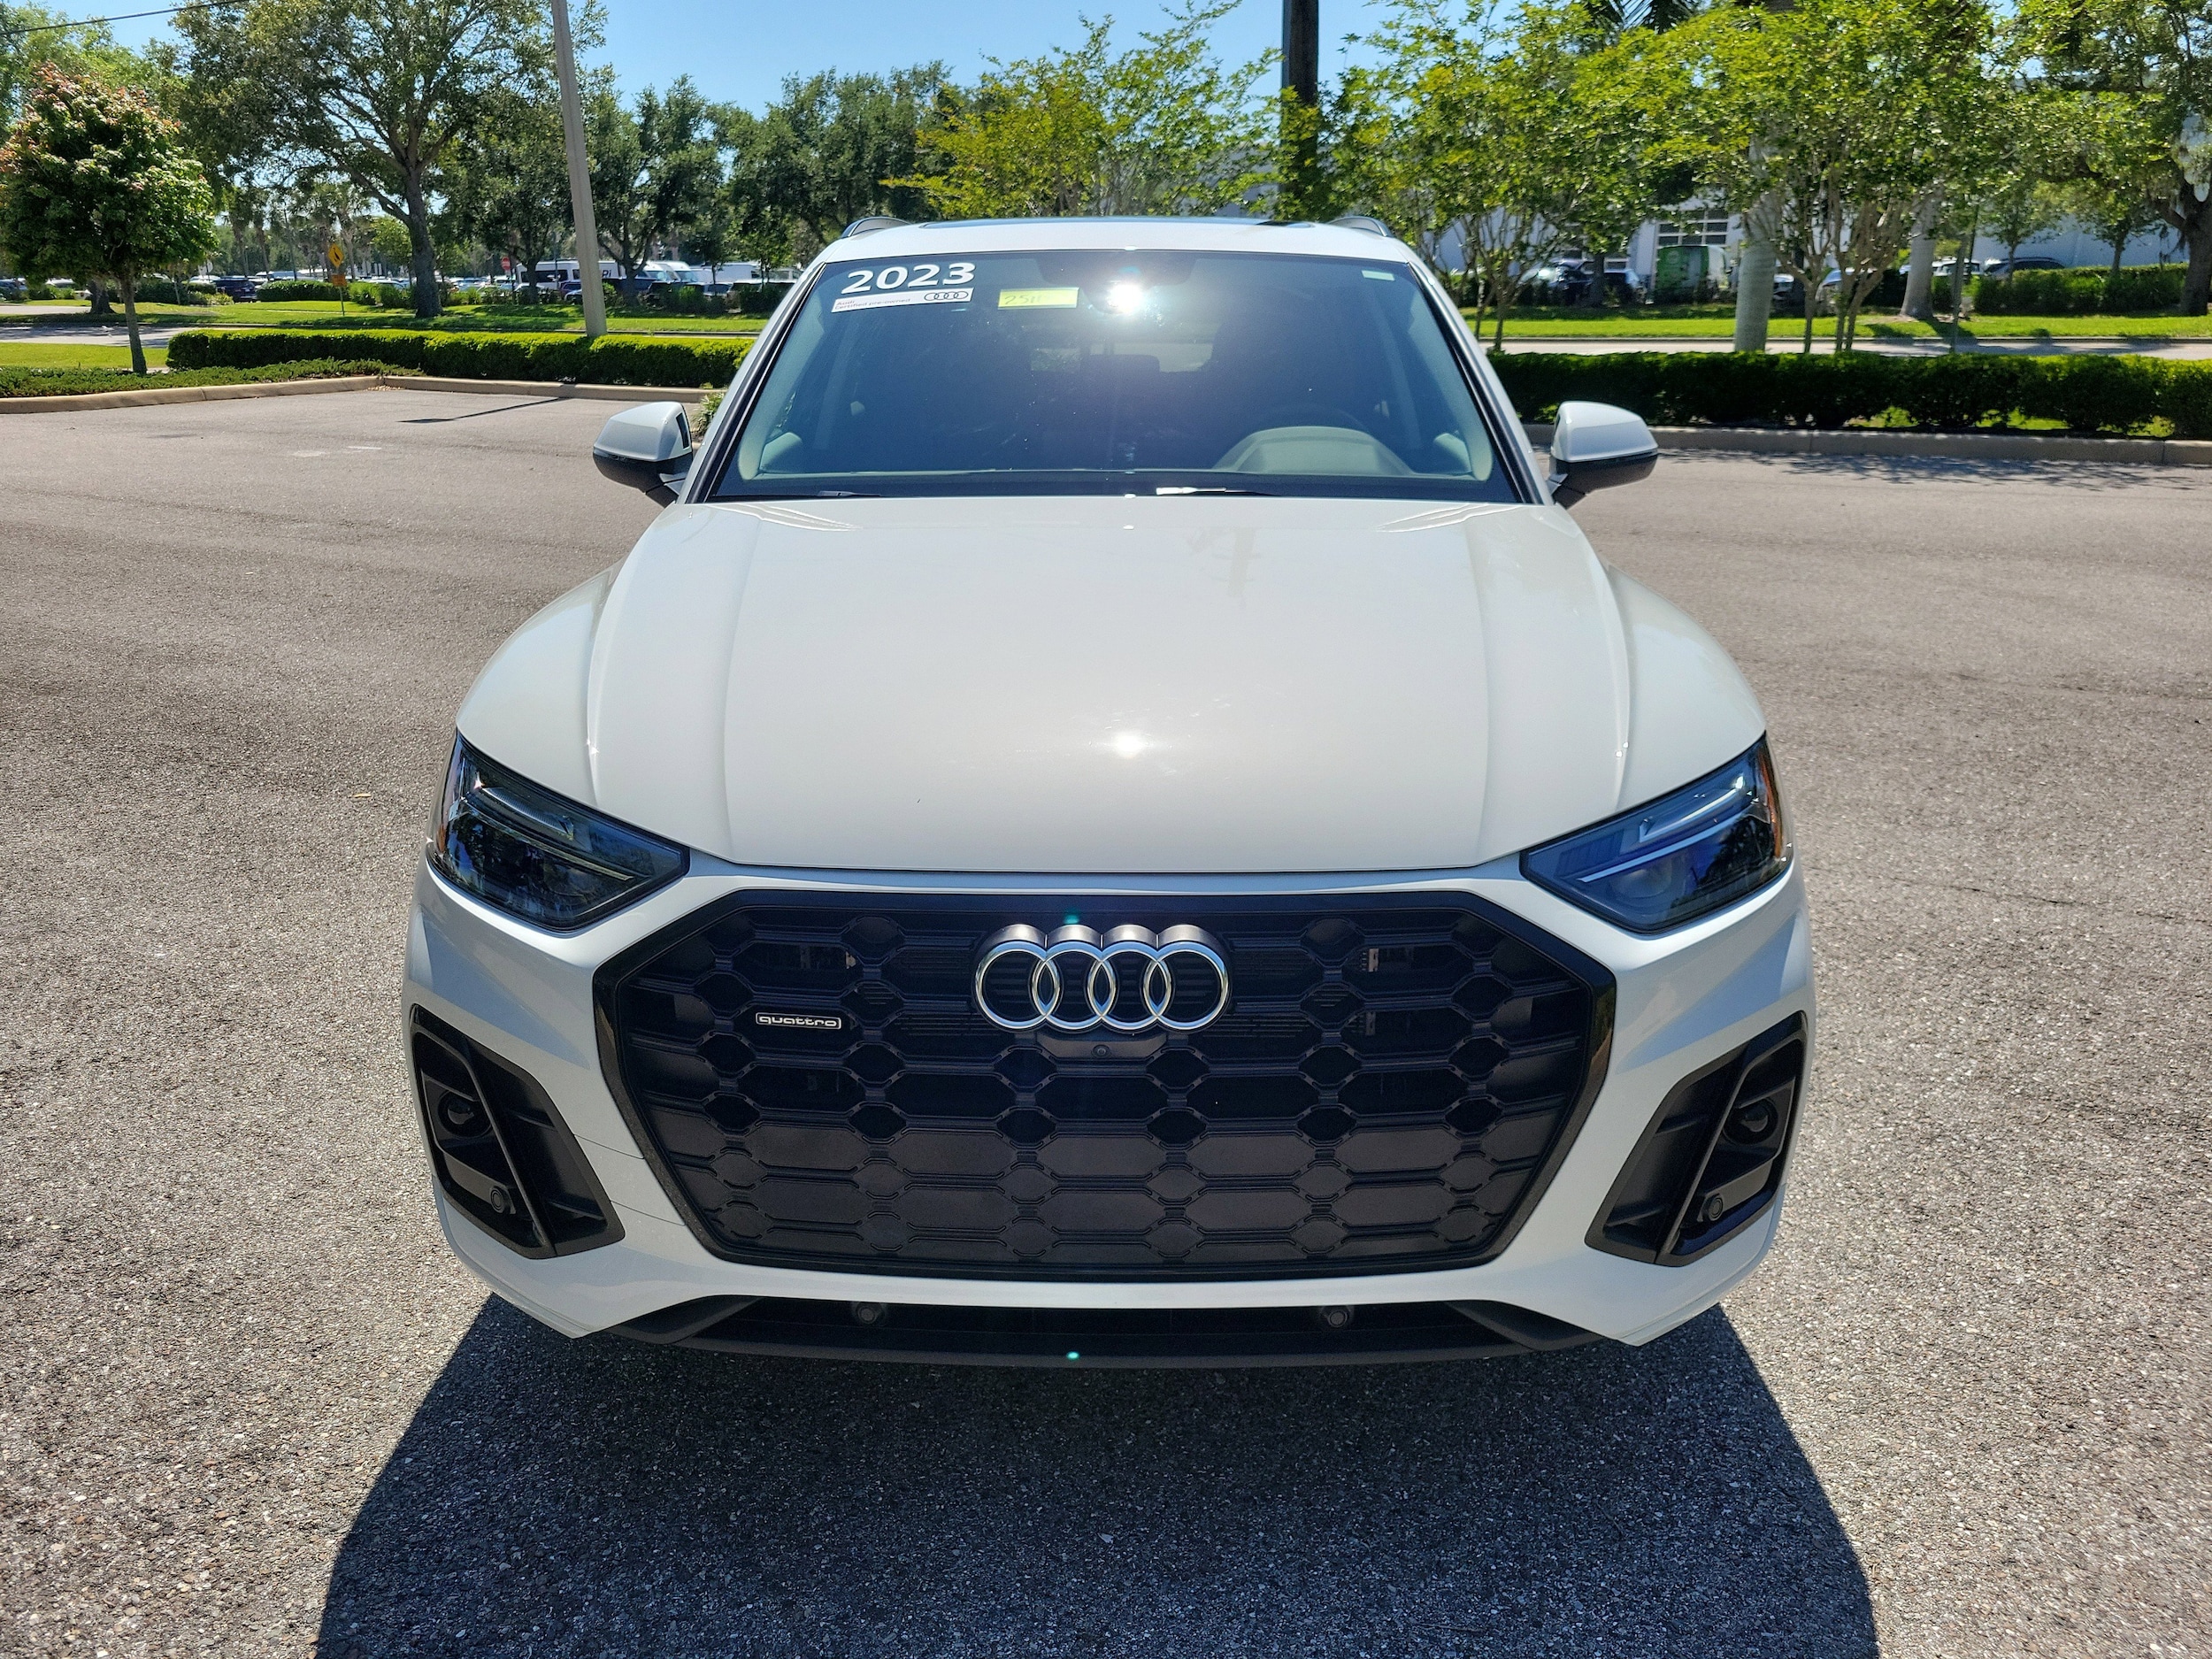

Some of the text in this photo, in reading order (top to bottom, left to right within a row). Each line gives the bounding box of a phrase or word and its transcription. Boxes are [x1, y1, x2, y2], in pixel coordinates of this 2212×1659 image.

[841, 262, 975, 294] 2023
[869, 298, 911, 307] pre-owned
[759, 1016, 837, 1026] quattro
